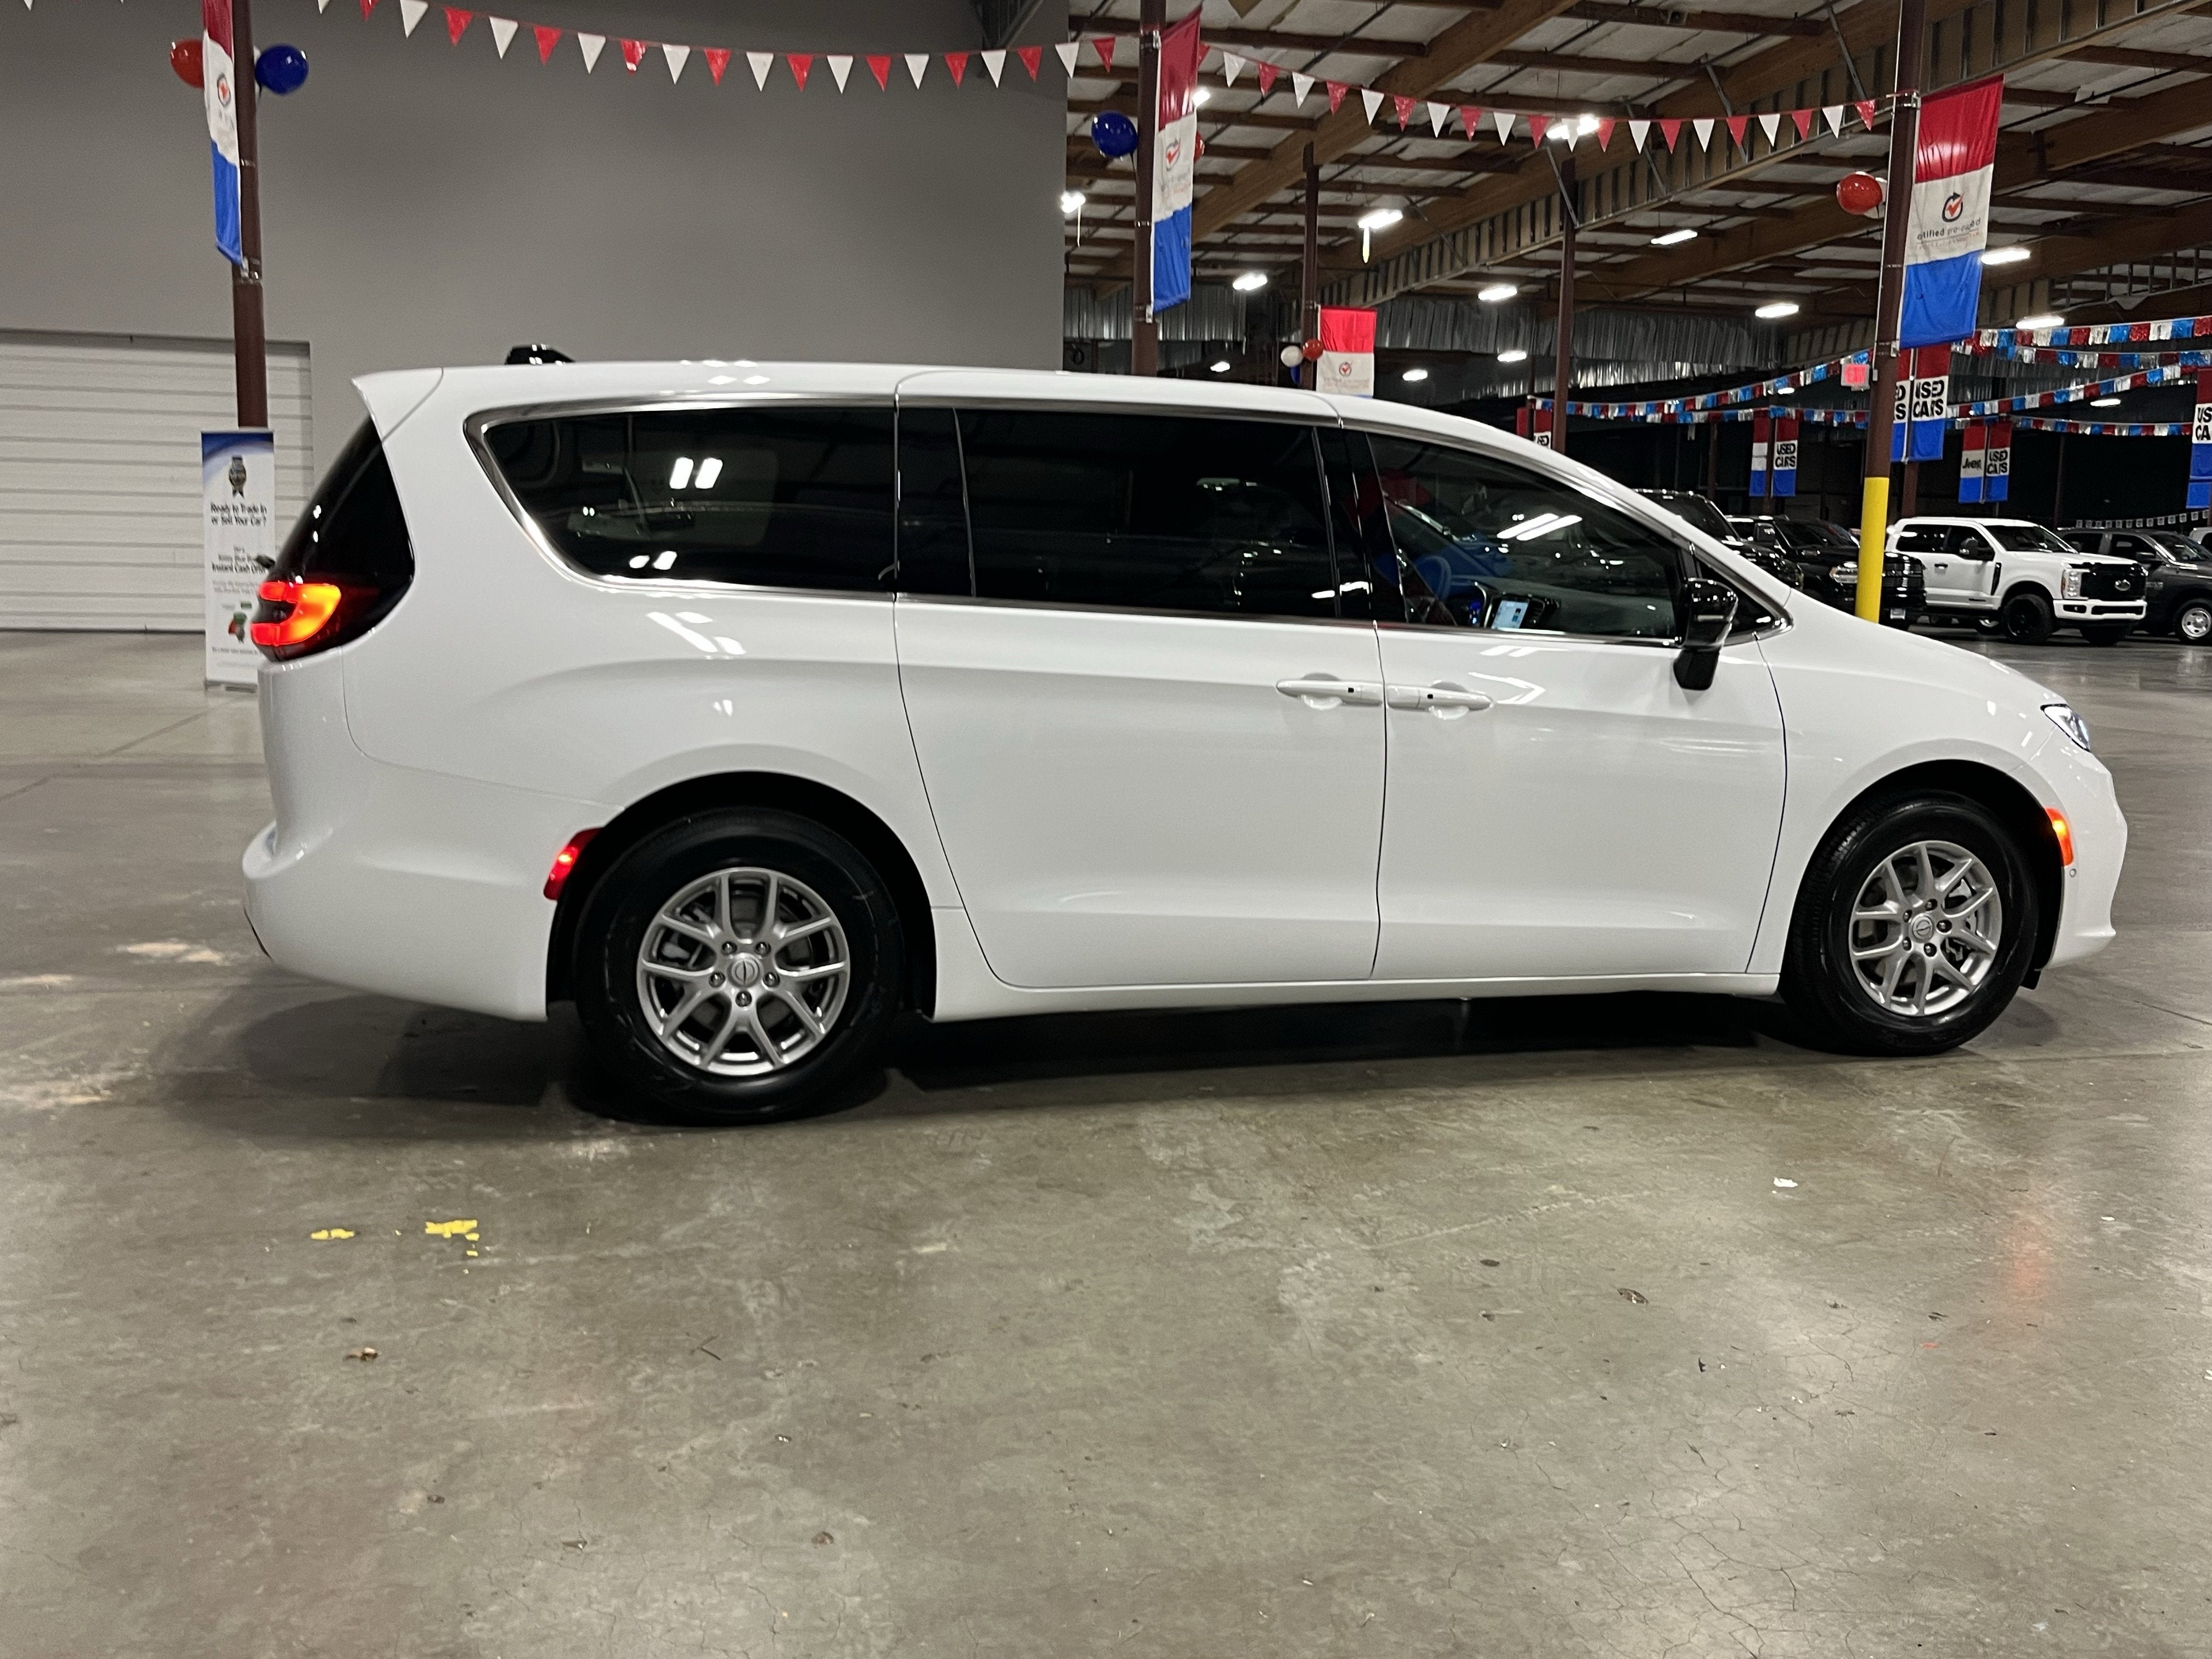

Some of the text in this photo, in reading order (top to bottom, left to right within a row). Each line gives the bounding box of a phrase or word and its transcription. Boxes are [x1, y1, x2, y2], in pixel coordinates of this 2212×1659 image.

[1915, 380, 1945, 399] USED
[2197, 407, 2212, 423] US
[2196, 425, 2211, 441] CA
[1777, 443, 1796, 455] USED
